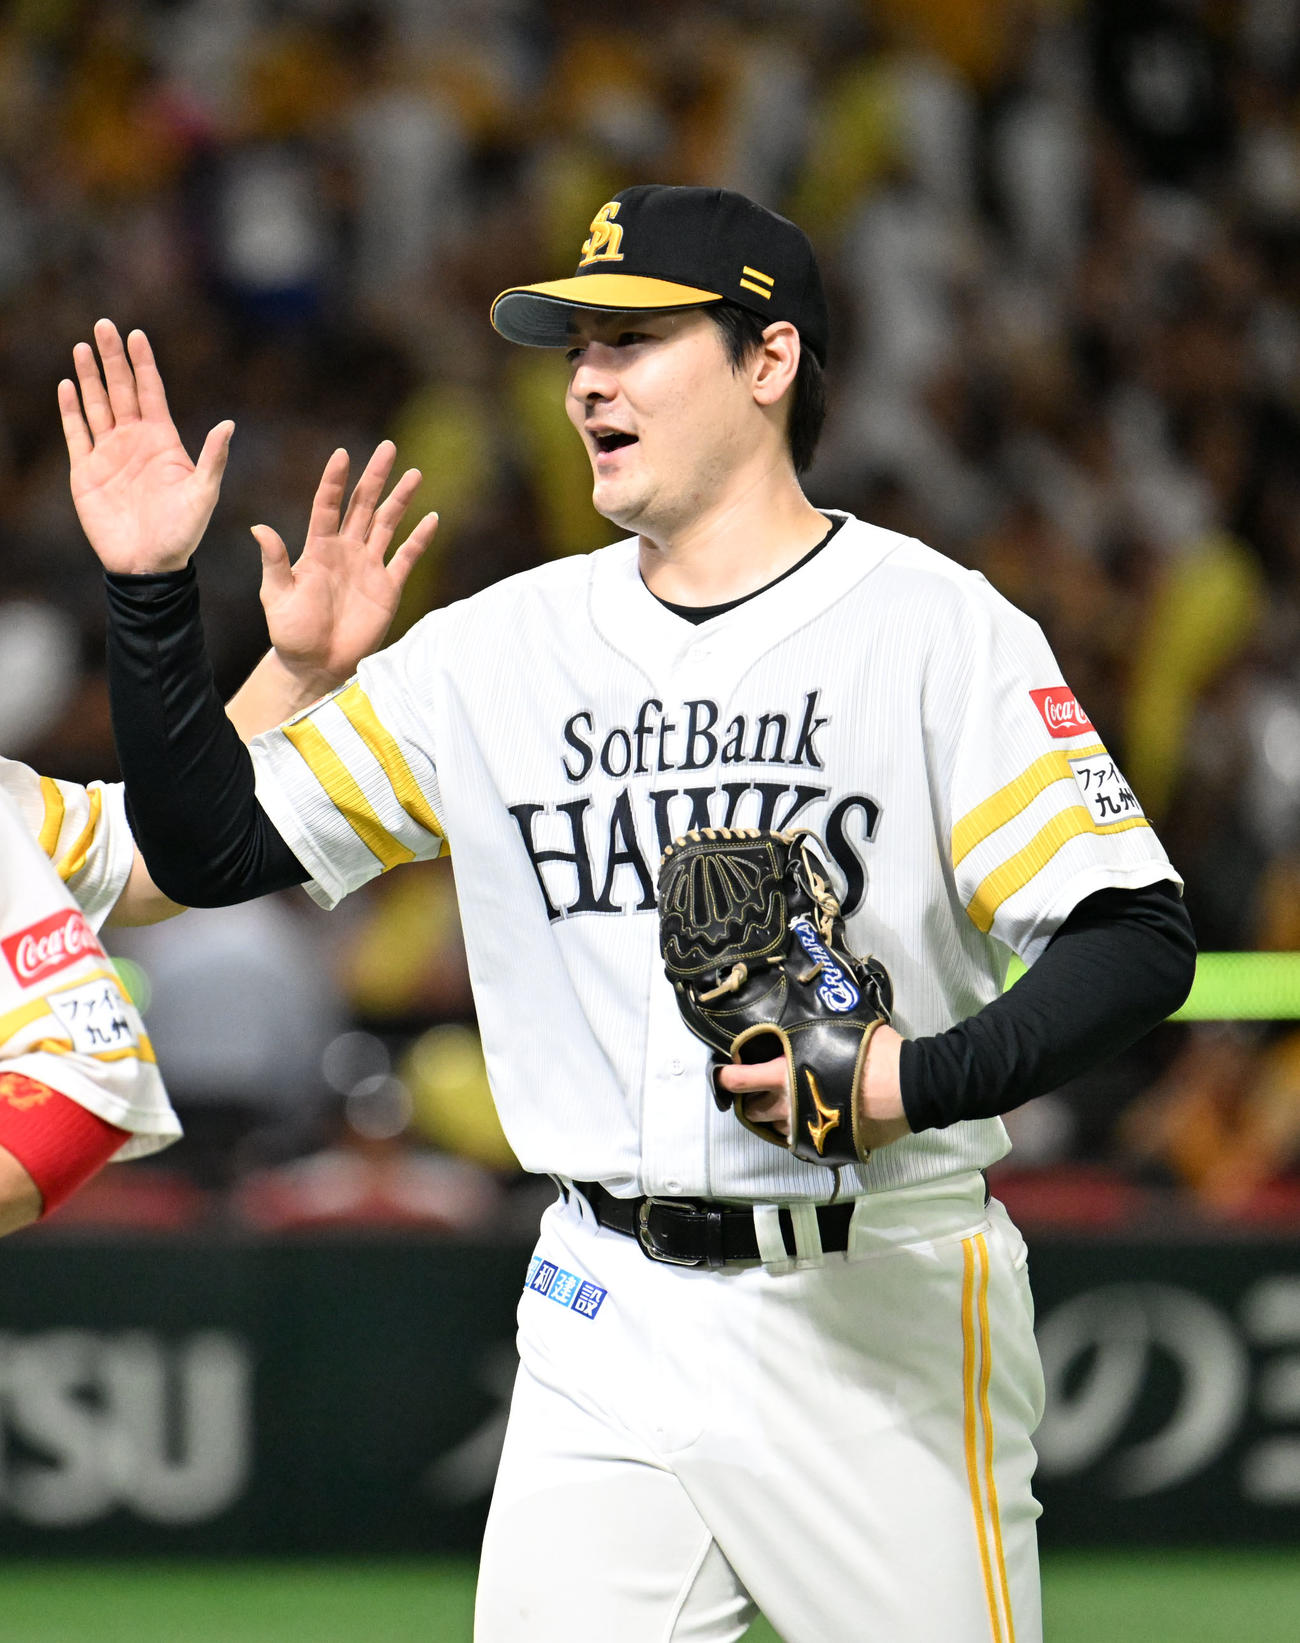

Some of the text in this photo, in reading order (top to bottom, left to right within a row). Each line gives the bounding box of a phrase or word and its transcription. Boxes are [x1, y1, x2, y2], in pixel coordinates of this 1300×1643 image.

[562, 688, 831, 783] SoftBank
[1076, 761, 1126, 791] ファイ
[1094, 787, 1140, 818] 九州
[60, 988, 121, 1020] ファイ
[0, 1327, 252, 1522] SU
